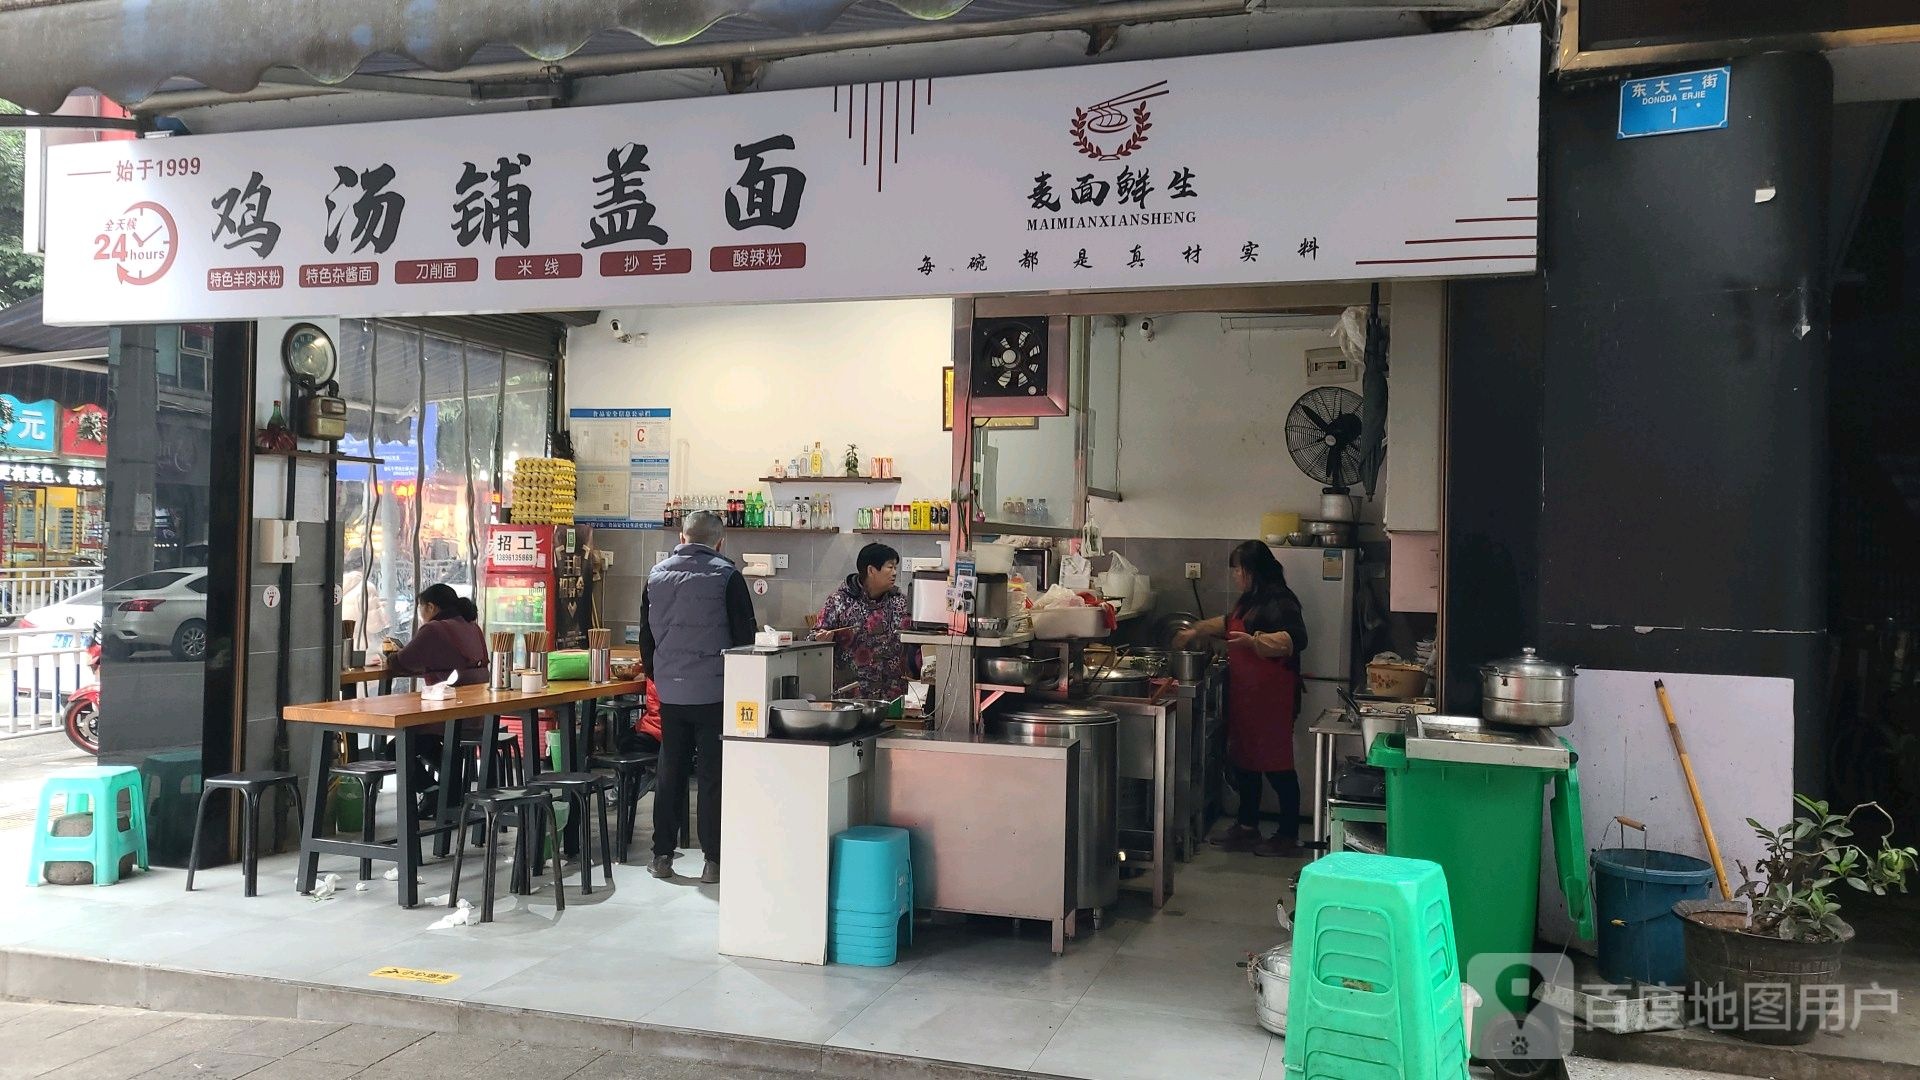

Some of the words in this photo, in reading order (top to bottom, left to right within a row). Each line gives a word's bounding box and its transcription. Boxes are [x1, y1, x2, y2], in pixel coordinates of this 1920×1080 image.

[1632, 73, 1718, 98] 东大二街
[1642, 94, 1677, 105] DONGDA
[1682, 90, 1706, 101] ERJIE
[1670, 106, 1677, 124] 1
[116, 157, 201, 182] 始于1999
[210, 133, 807, 260] 鸡汤铺盖面
[104, 217, 138, 232] 全天候
[1026, 210, 1198, 231] MAIMIANXIANSHENG
[93, 233, 128, 262] 24
[130, 249, 165, 260] hours
[917, 236, 1320, 276] 每碗都是真材实料
[623, 253, 668, 273] 抄手
[732, 248, 783, 268] 酸辣粉
[209, 270, 281, 289] 特色羊肉米粉
[305, 265, 373, 285] 特色杂酱面
[415, 262, 457, 280] 刀削面
[637, 428, 645, 442] C
[268, 595, 274, 606] 7
[740, 706, 754, 721] 拉
